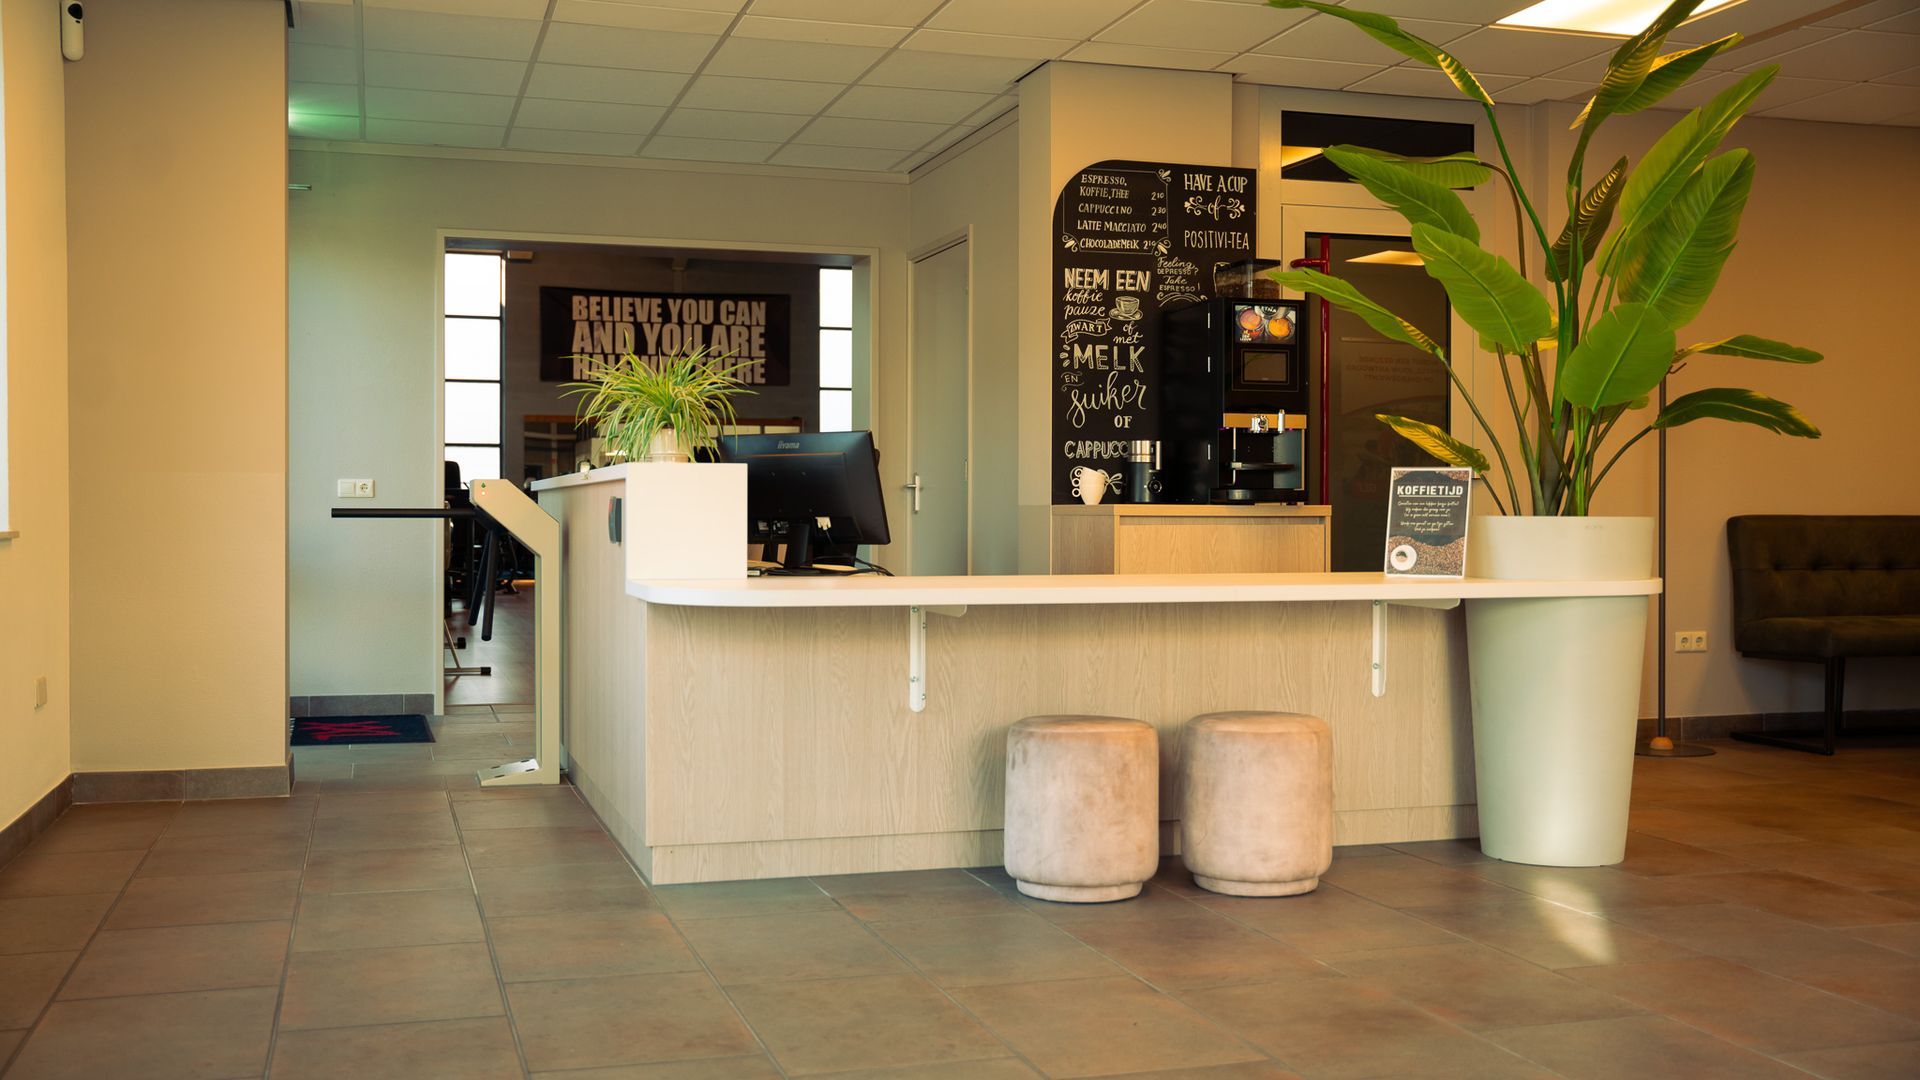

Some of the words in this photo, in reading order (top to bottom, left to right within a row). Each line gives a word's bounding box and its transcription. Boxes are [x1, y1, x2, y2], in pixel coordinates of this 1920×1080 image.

[1081, 174, 1127, 186] ESPRESSO,
[1184, 173, 1213, 191] HAVE
[1228, 175, 1248, 193] CUP
[1078, 203, 1133, 215] CAPPUCCINO
[1207, 195, 1223, 221] of
[1077, 220, 1102, 231] LATTE
[1103, 221, 1147, 233] MACCIATO
[1184, 230, 1250, 250] POSITIVI-TEA
[1064, 268, 1110, 290] NEEM
[1116, 269, 1151, 293] EEN
[1164, 275, 1188, 285] Take
[1063, 287, 1104, 305] koffie
[572, 295, 663, 323] BELIEVE
[667, 299, 715, 325] YOU
[719, 300, 766, 326] CAN
[1063, 304, 1106, 320] pauze
[1068, 322, 1103, 334] ZWART
[1123, 321, 1137, 335] of
[571, 320, 635, 354] AND
[641, 323, 704, 356] YOU
[708, 325, 766, 358] ARE
[1113, 331, 1143, 344] met
[1073, 343, 1146, 373] MELK
[1064, 375, 1079, 383] EN
[1066, 370, 1147, 429] suiker
[1113, 415, 1133, 428] OF
[1397, 485, 1464, 495] KOFFIETIJD
